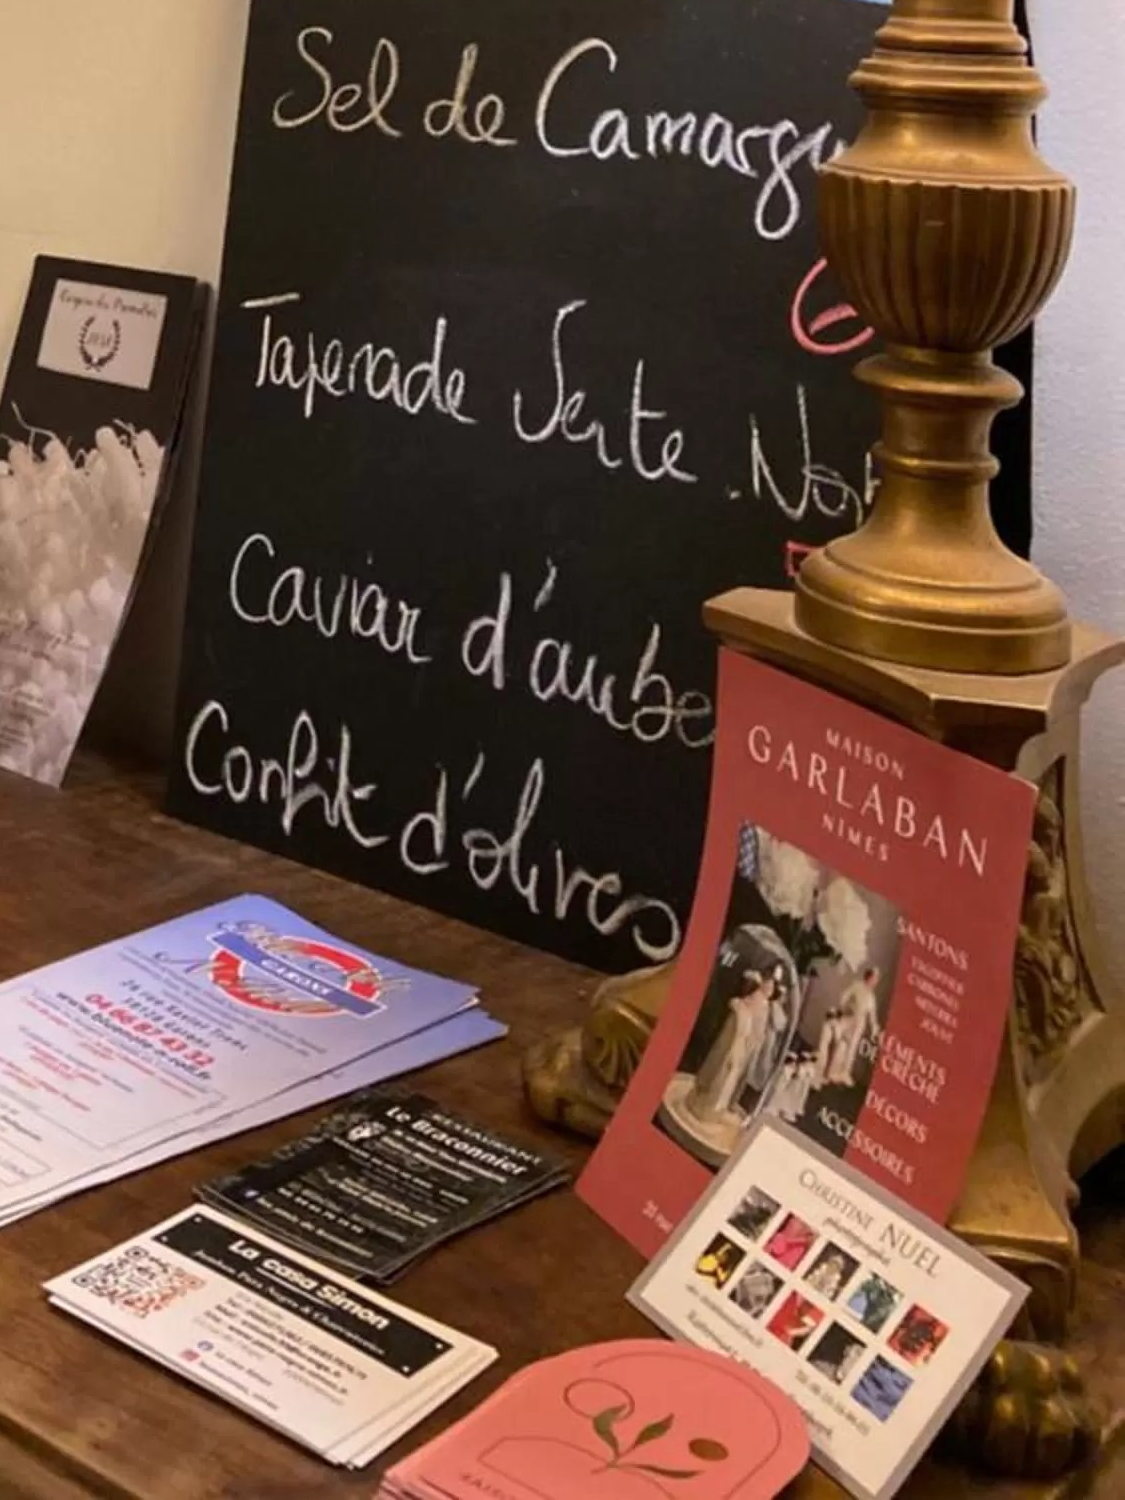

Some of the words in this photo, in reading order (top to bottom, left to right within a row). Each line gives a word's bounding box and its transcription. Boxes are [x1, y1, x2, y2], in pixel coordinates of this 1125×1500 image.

[271, 25, 403, 139] Sel
[422, 43, 519, 146] de
[228, 531, 433, 663] Caviar
[825, 727, 905, 781] MAISON
[185, 700, 391, 850] Confit
[399, 748, 683, 963] d'olives
[747, 724, 988, 878] GARLABAN
[896, 915, 969, 972] SANTONS
[381, 1105, 418, 1123] Le
[404, 1118, 536, 1176] Braconnier
[816, 1103, 917, 1187] ACCESSOIRES
[224, 1238, 266, 1261] La
[258, 1256, 322, 1291] casa
[310, 1283, 397, 1331] Simon
[877, 1221, 947, 1279] NUEL
